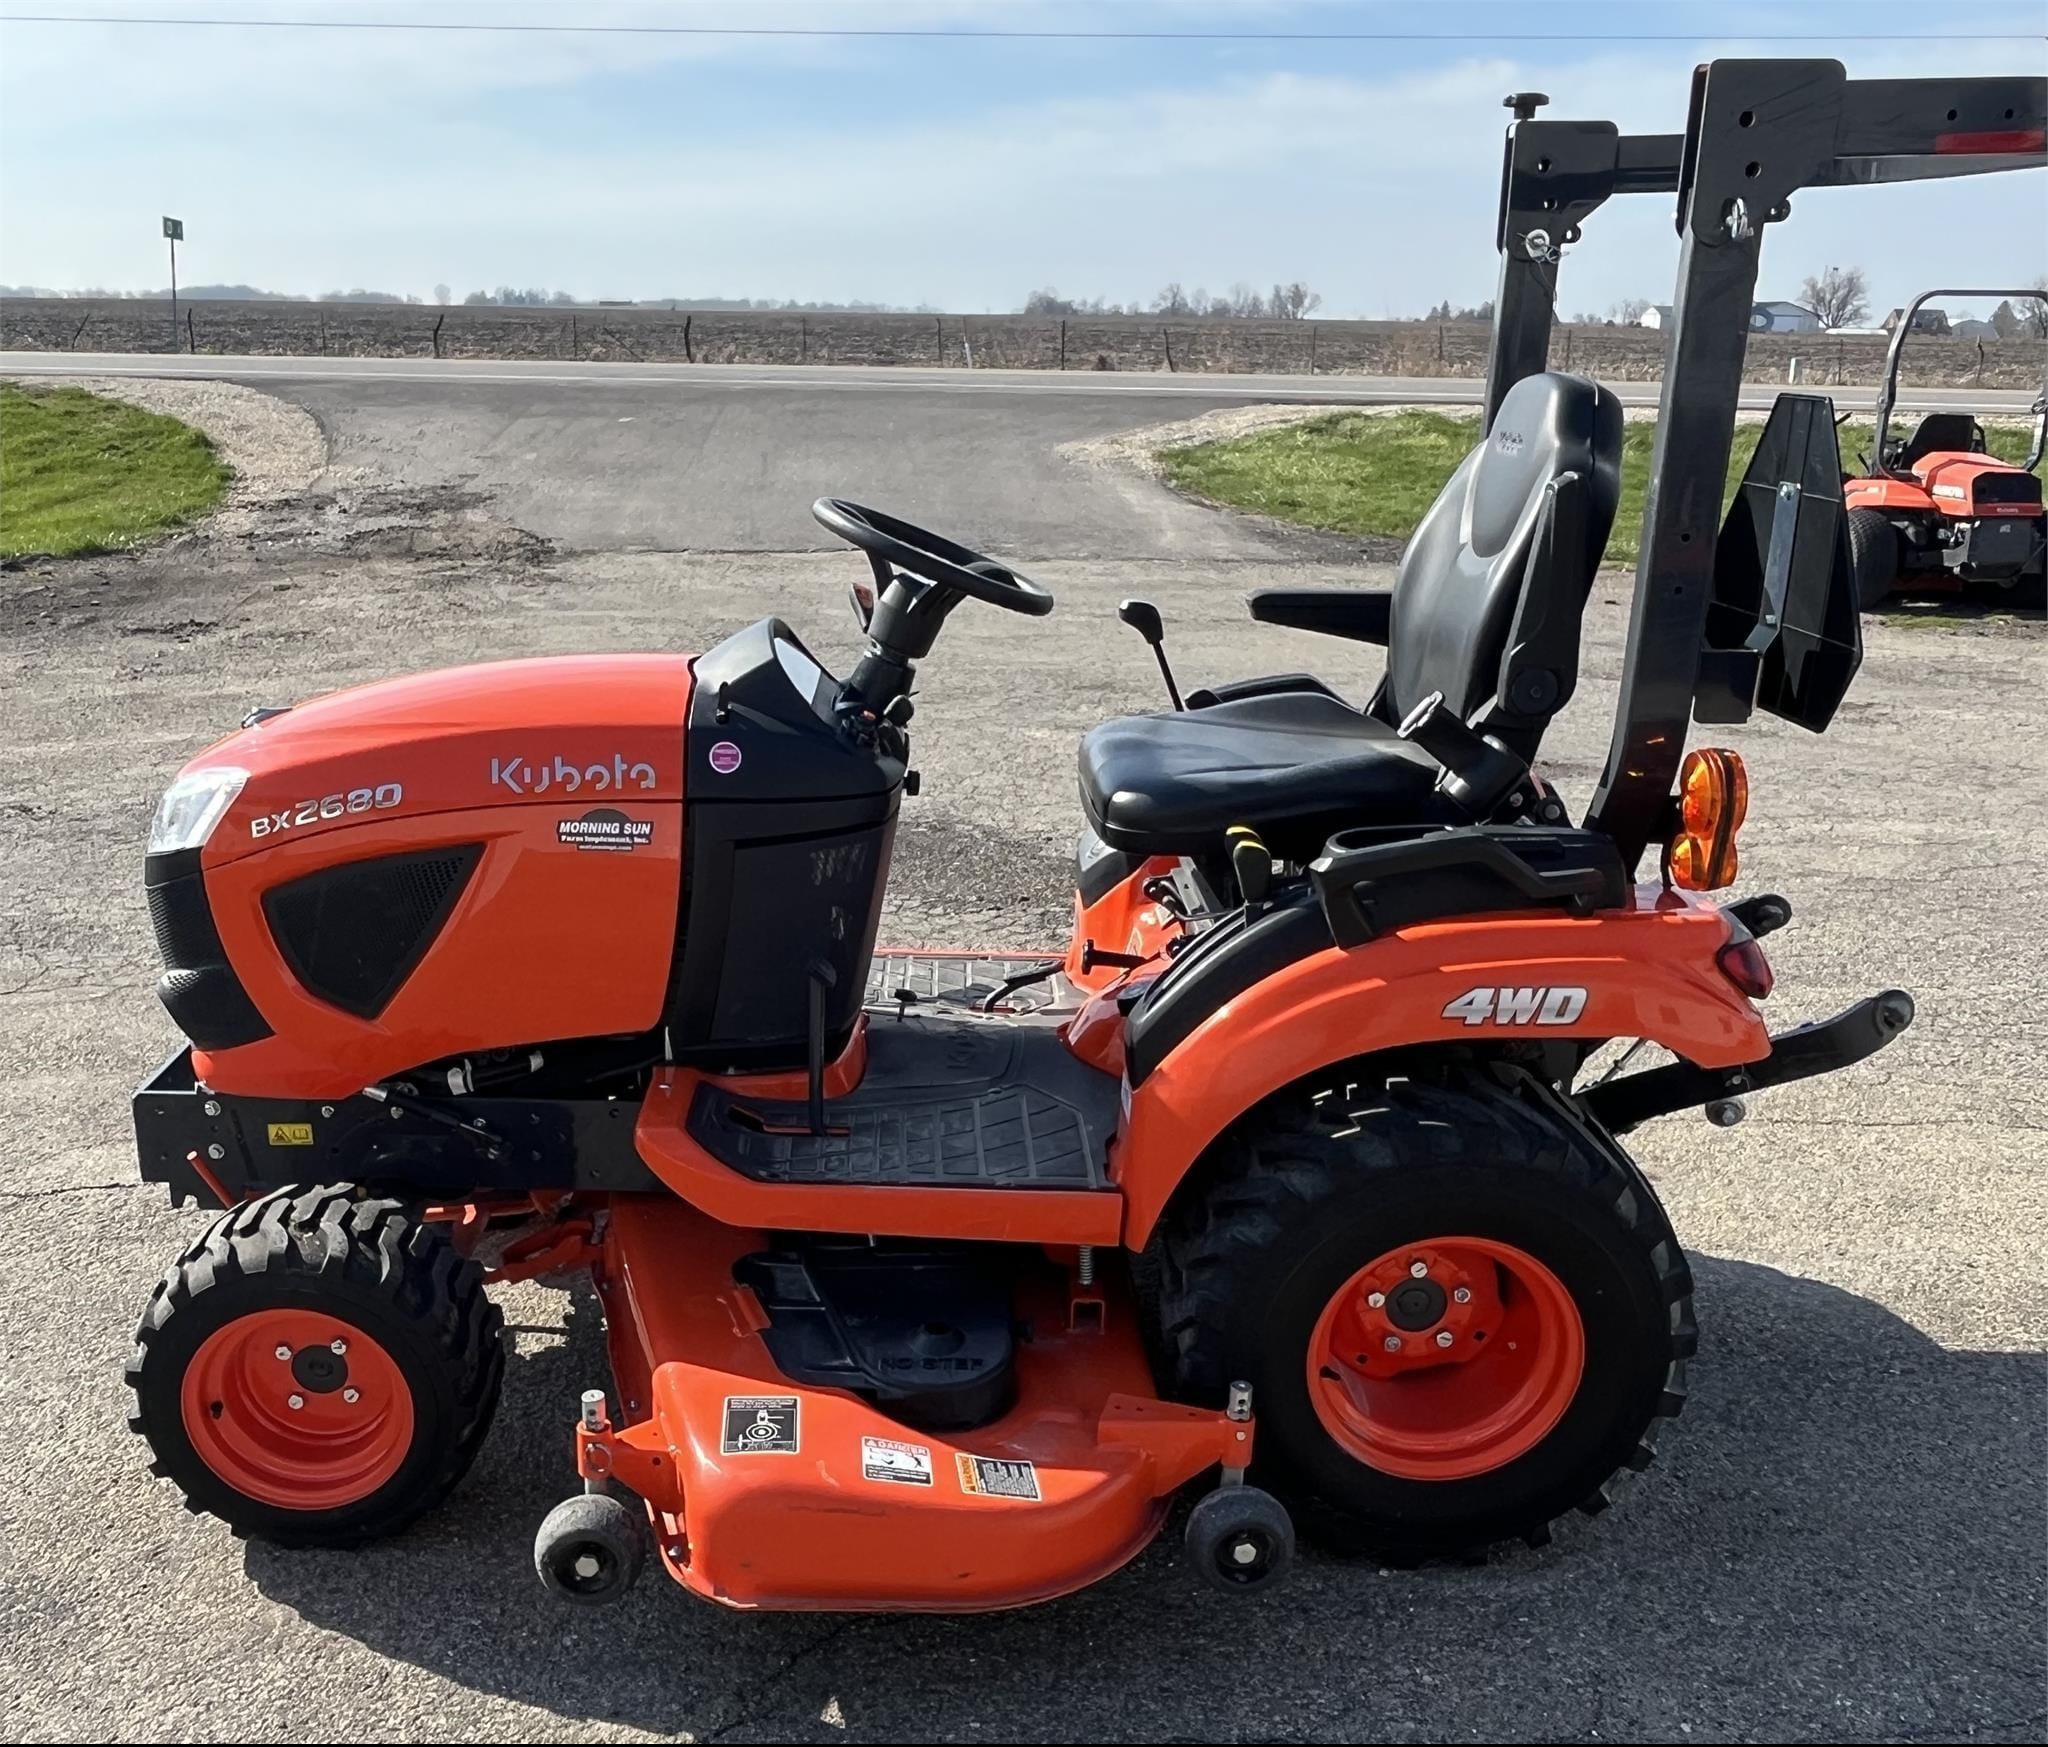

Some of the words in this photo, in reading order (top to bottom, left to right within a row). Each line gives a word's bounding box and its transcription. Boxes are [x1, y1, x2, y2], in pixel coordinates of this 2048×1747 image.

[490, 753, 656, 794] Kubota
[251, 783, 403, 838] BX2680
[559, 821, 620, 834] MORNING
[623, 822, 651, 835] SUN
[1441, 986, 1588, 1025] 4WD
